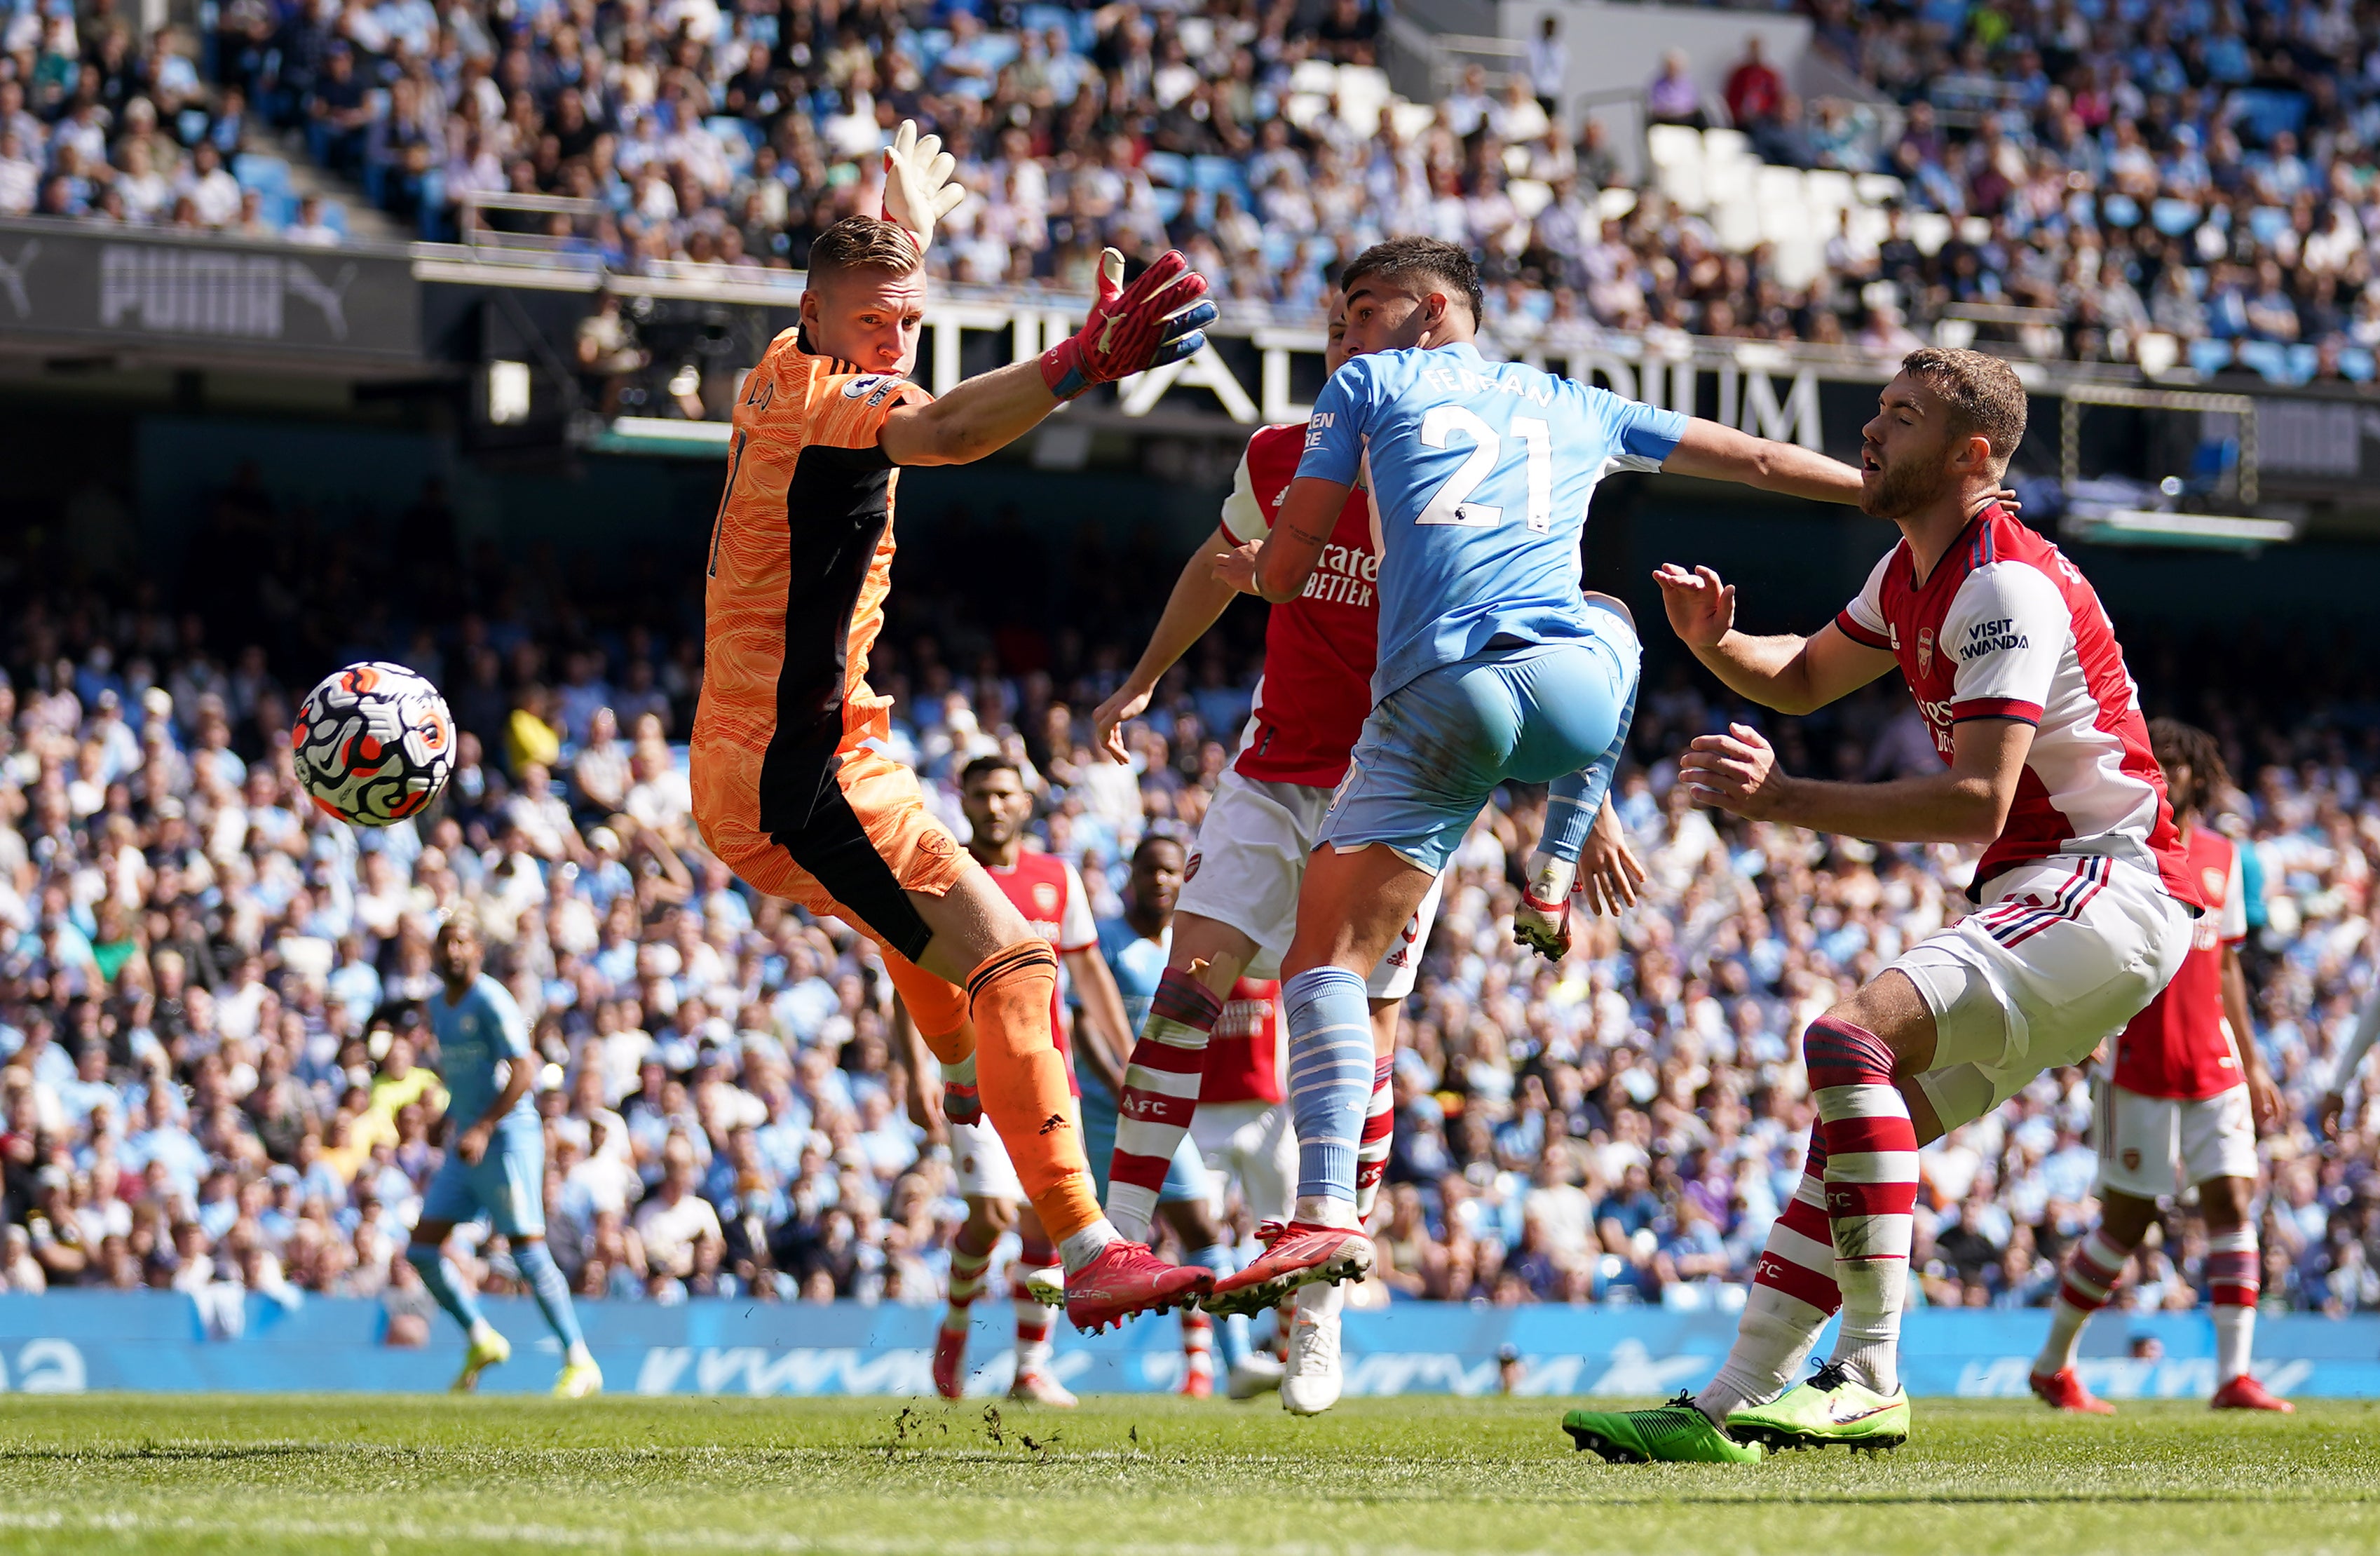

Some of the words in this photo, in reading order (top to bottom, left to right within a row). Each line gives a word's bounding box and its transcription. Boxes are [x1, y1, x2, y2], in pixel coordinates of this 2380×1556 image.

[100, 243, 285, 339] PUMA
[1421, 367, 1554, 408] FERRAN
[1308, 412, 1335, 429] EN
[1414, 405, 1553, 536] 21
[1302, 571, 1373, 607] BETTER
[1968, 618, 2013, 640] VISIT
[1122, 1093, 1168, 1115] AFC
[1757, 1259, 1783, 1279] FC
[1068, 1289, 1113, 1300] ULTRA
[0, 1337, 88, 1394] a
